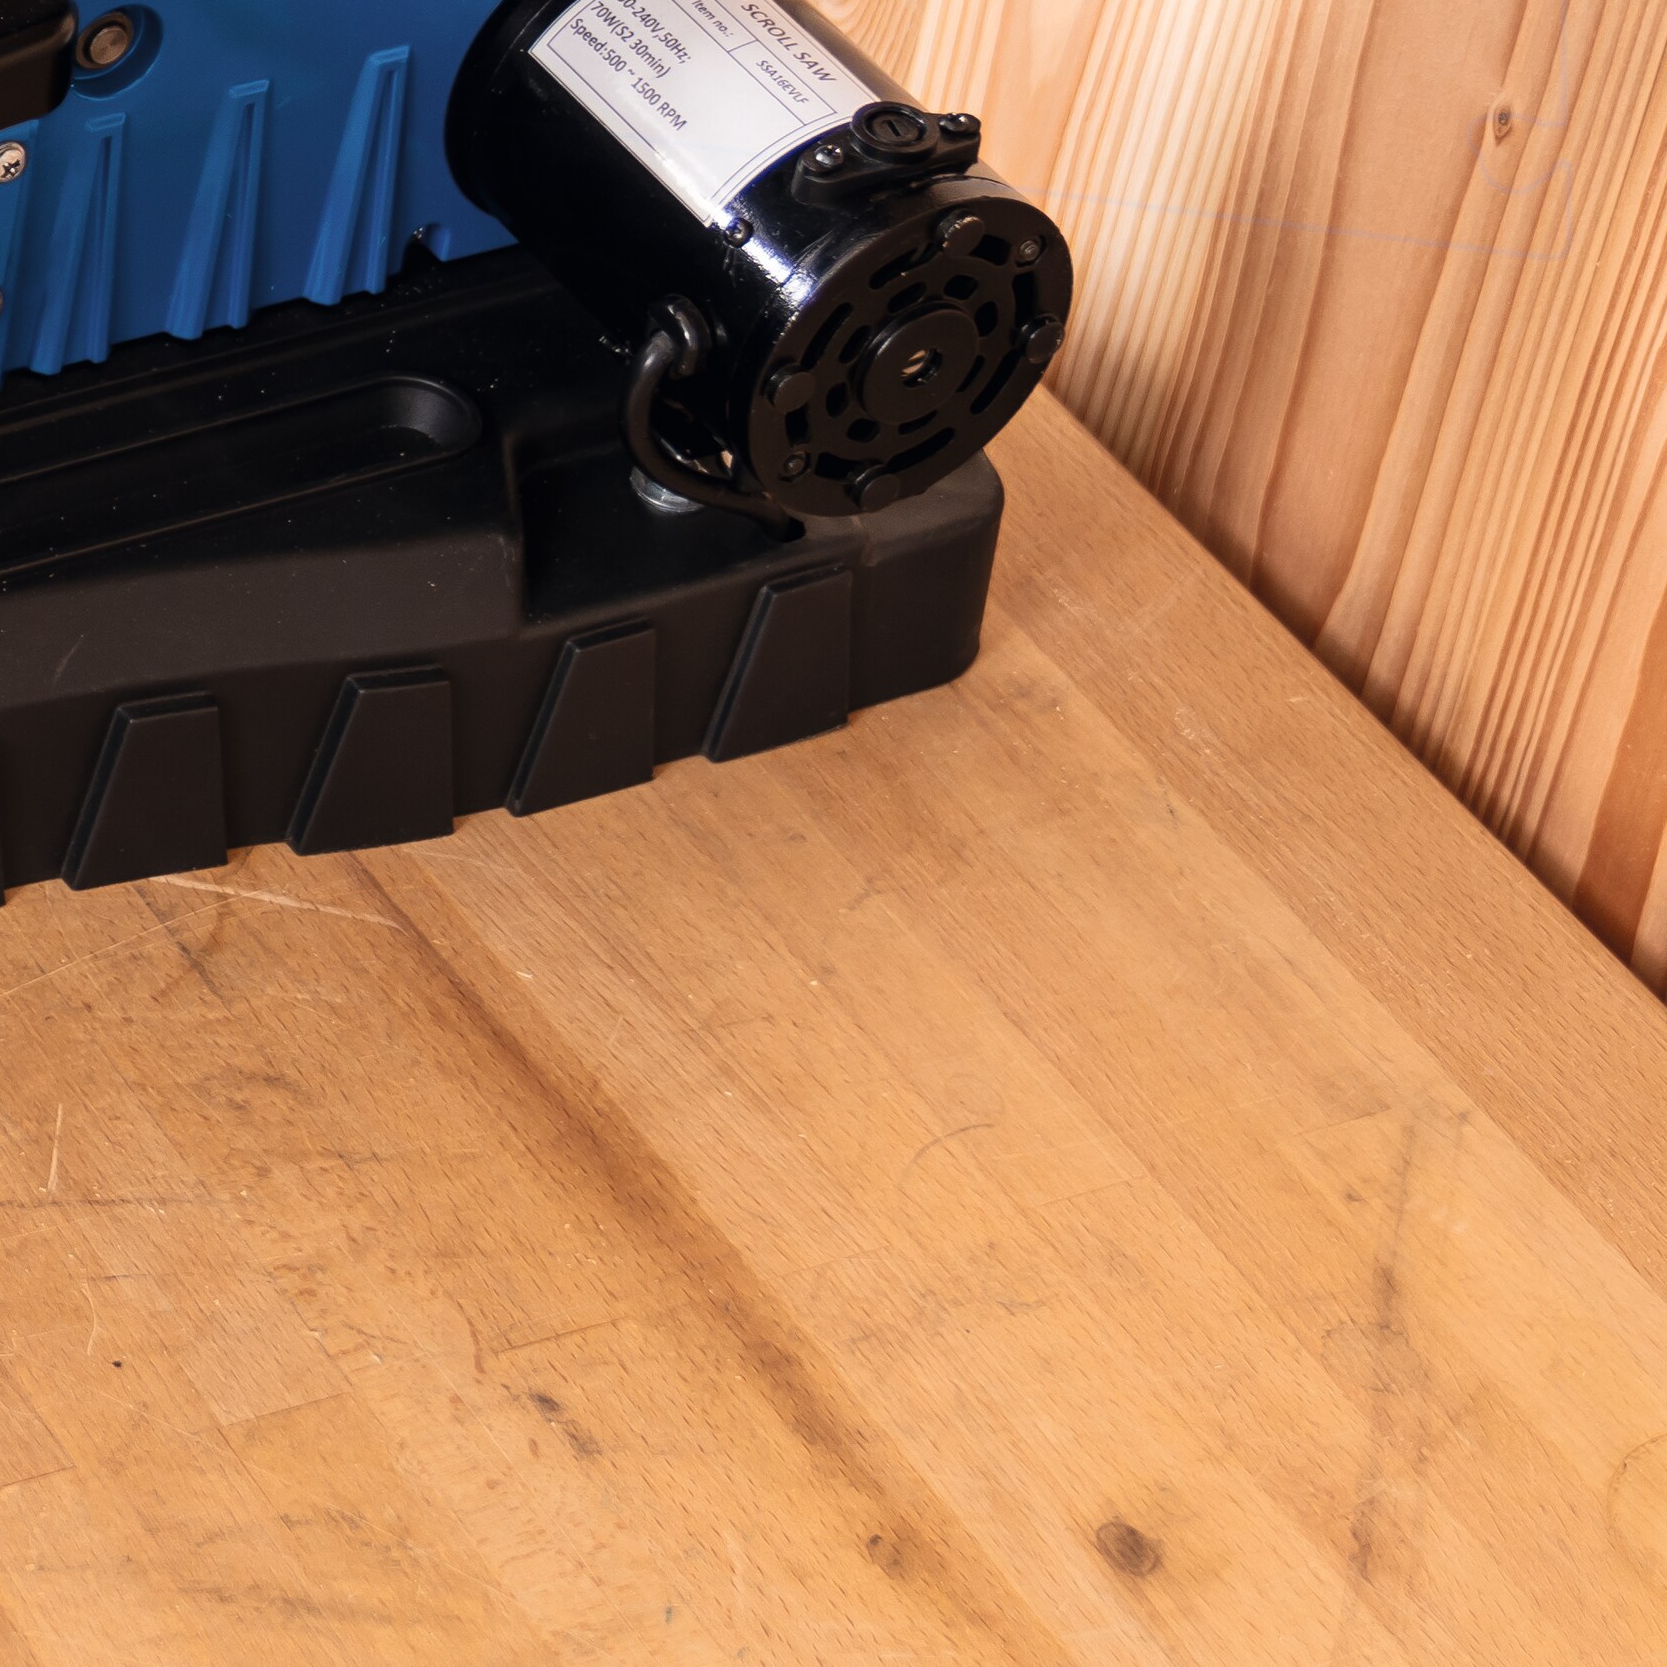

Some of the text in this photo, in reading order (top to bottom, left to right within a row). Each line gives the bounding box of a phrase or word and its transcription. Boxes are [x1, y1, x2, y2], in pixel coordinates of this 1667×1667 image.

[590, 1, 672, 78] 70W(S2 30min)
[692, 0, 716, 21] Item
[741, 3, 798, 51] SCROLL
[793, 52, 837, 82] SAW
[570, 18, 627, 72] Speed:500
[631, 77, 661, 106] 1500
[657, 102, 687, 131] RPM
[756, 60, 809, 104] SSA16EVLF
